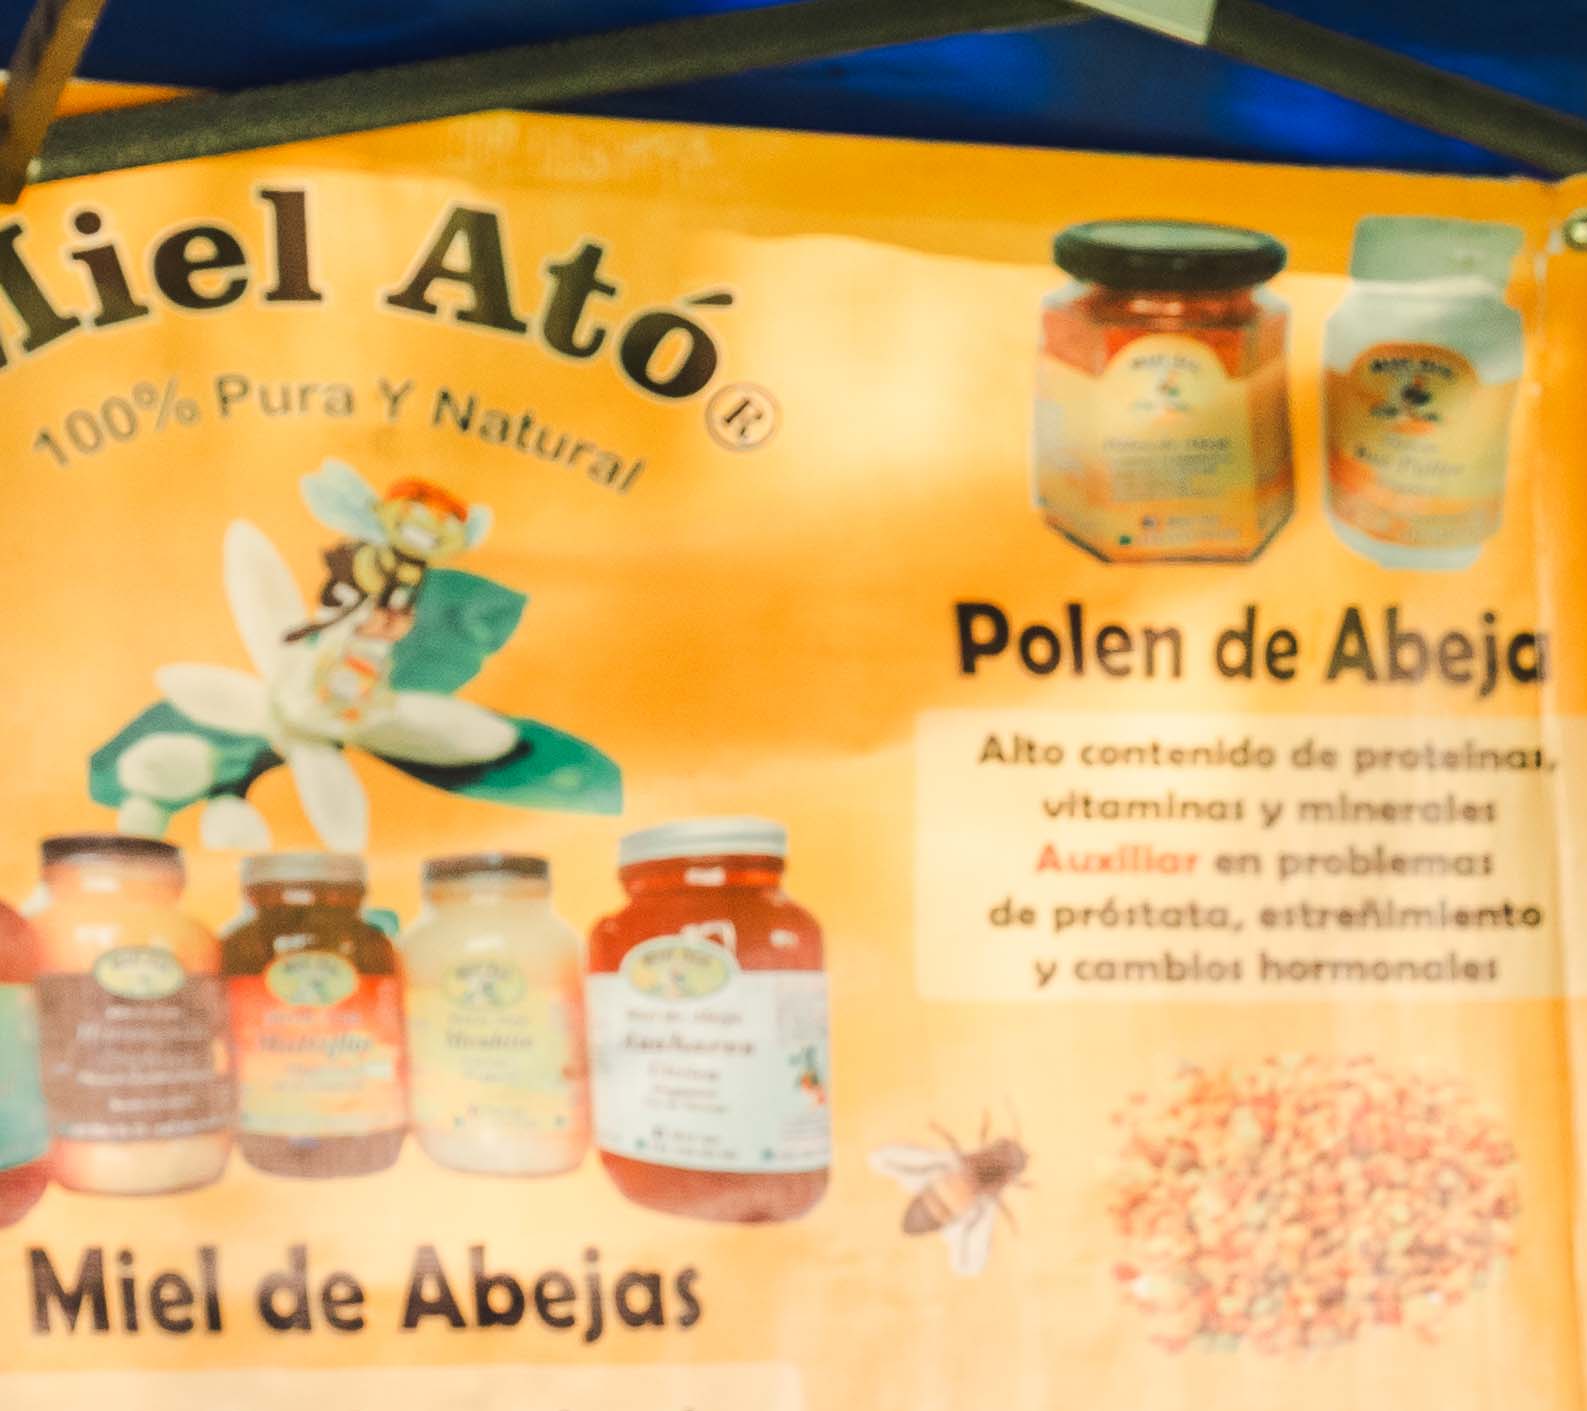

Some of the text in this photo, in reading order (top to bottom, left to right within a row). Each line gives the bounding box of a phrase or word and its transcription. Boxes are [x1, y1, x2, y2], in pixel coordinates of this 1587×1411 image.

[386, 206, 734, 399] Ató
[30, 373, 645, 495] 100% Pura Y Natural
[955, 602, 1549, 699] Polen de Abeja
[978, 734, 1063, 766] Alto
[1080, 736, 1276, 769] contenido
[1291, 738, 1338, 770] de
[1042, 790, 1498, 827] vitaminas y minerales
[1036, 845, 1495, 880] Auxiliar en problemas
[988, 898, 1543, 933] de próstata, estreñimiento
[1035, 953, 1499, 987] y cambios hormonales
[28, 1244, 703, 1343] Miel de Abejas
